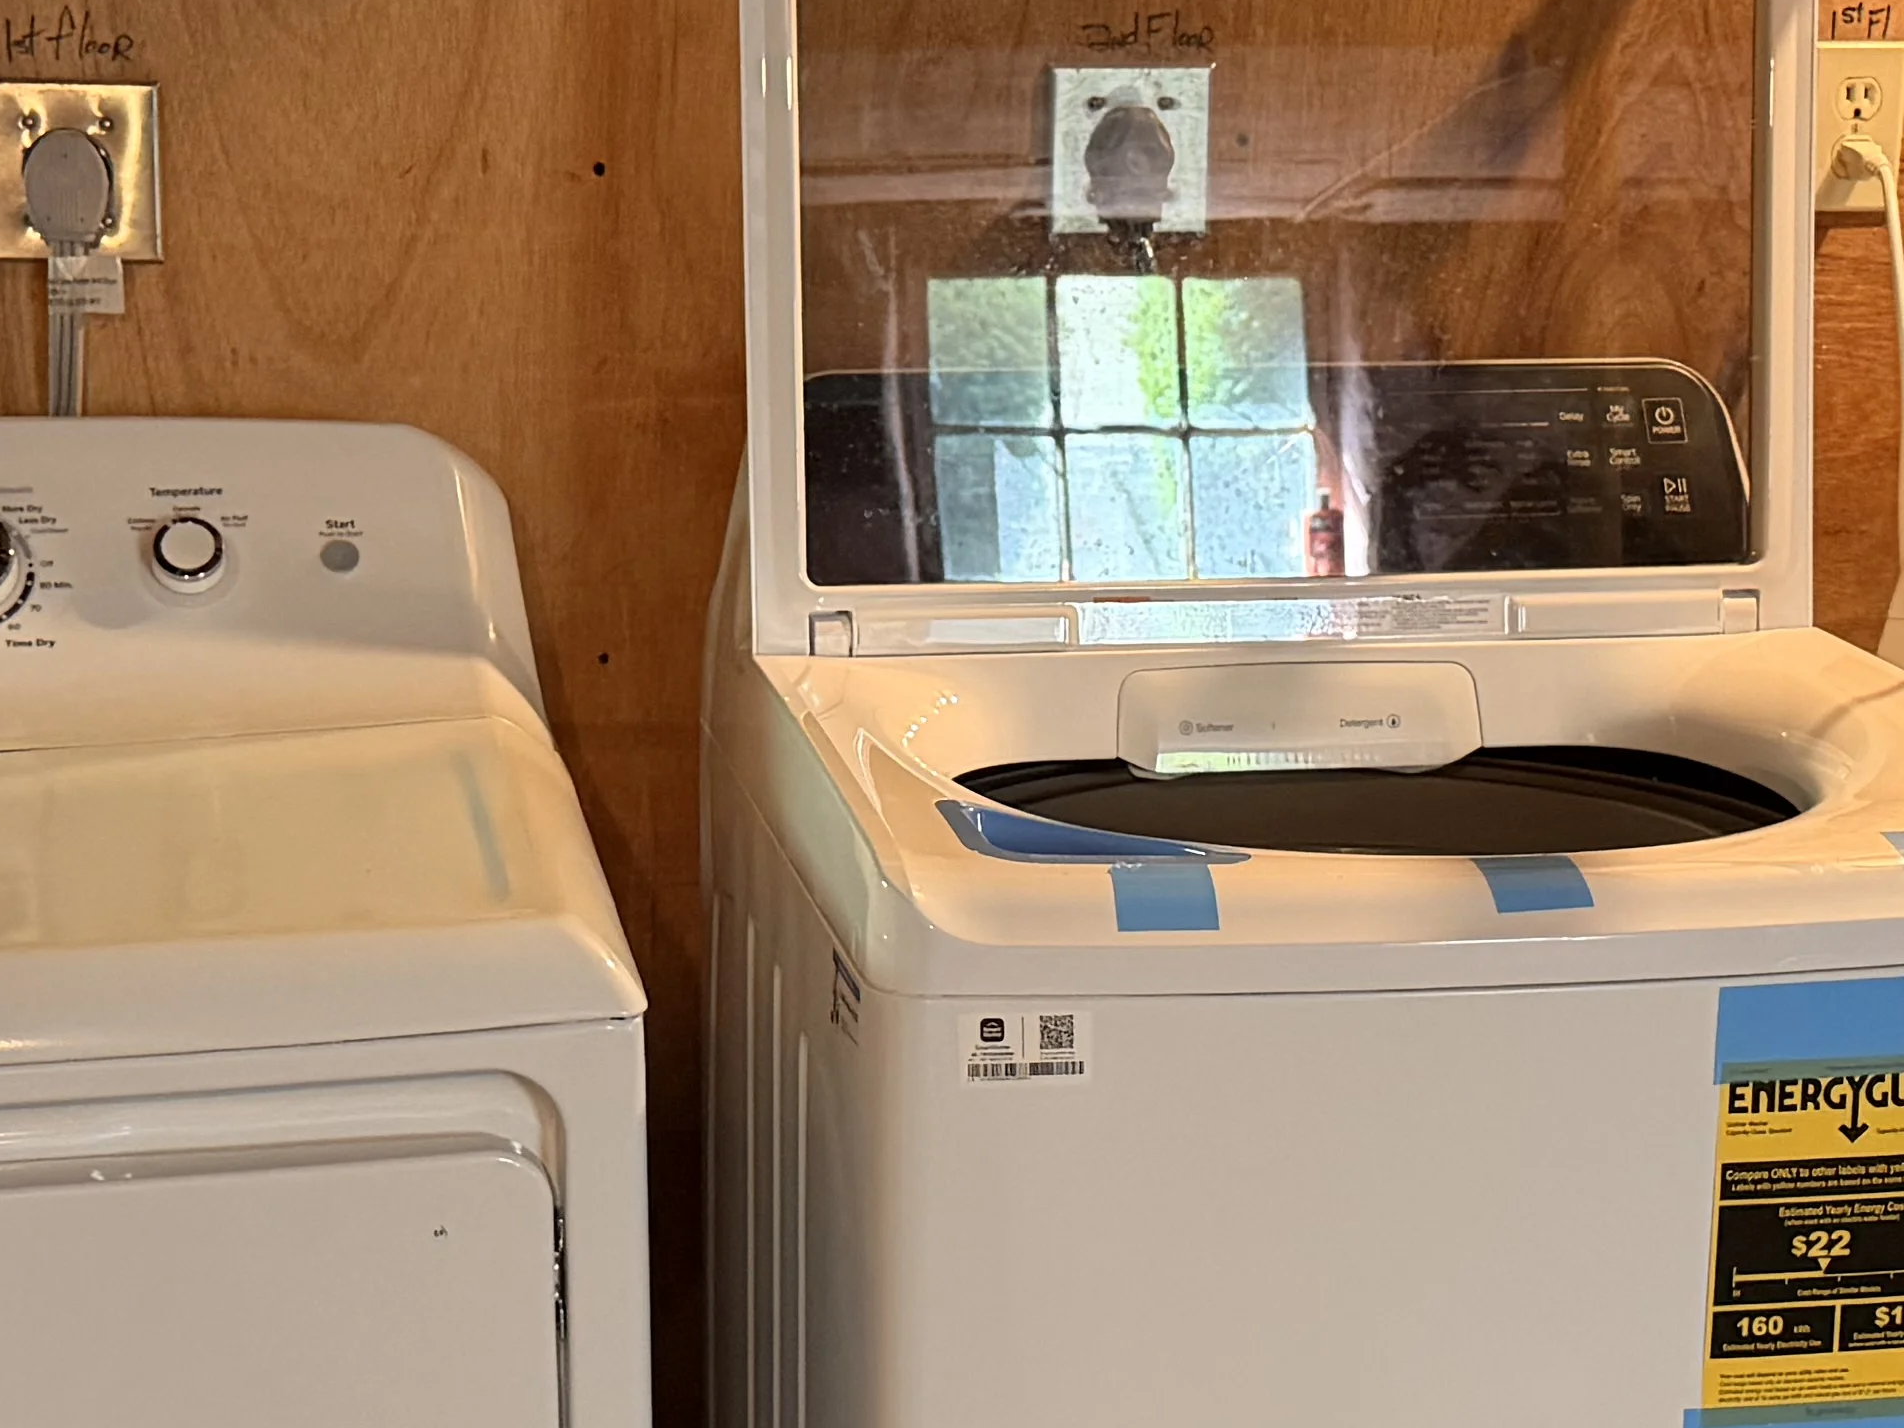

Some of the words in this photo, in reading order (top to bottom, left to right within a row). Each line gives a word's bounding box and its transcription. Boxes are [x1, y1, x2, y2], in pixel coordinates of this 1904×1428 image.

[149, 486, 224, 499] Temperature
[325, 519, 356, 530] Start
[35, 638, 57, 649] Dry
[1725, 1168, 1769, 1181] Compare
[1770, 1168, 1798, 1179] ONLY
[1799, 1168, 1810, 1177] to
[1812, 1166, 1837, 1176] other
[1838, 1165, 1866, 1175] labels
[1868, 1163, 1888, 1174] with
[1779, 1206, 1824, 1218] Estimated
[1825, 1204, 1852, 1217] Yearly
[1854, 1202, 1885, 1215] Energy
[1791, 1229, 1852, 1258] $22
[1737, 1315, 1784, 1337] 160
